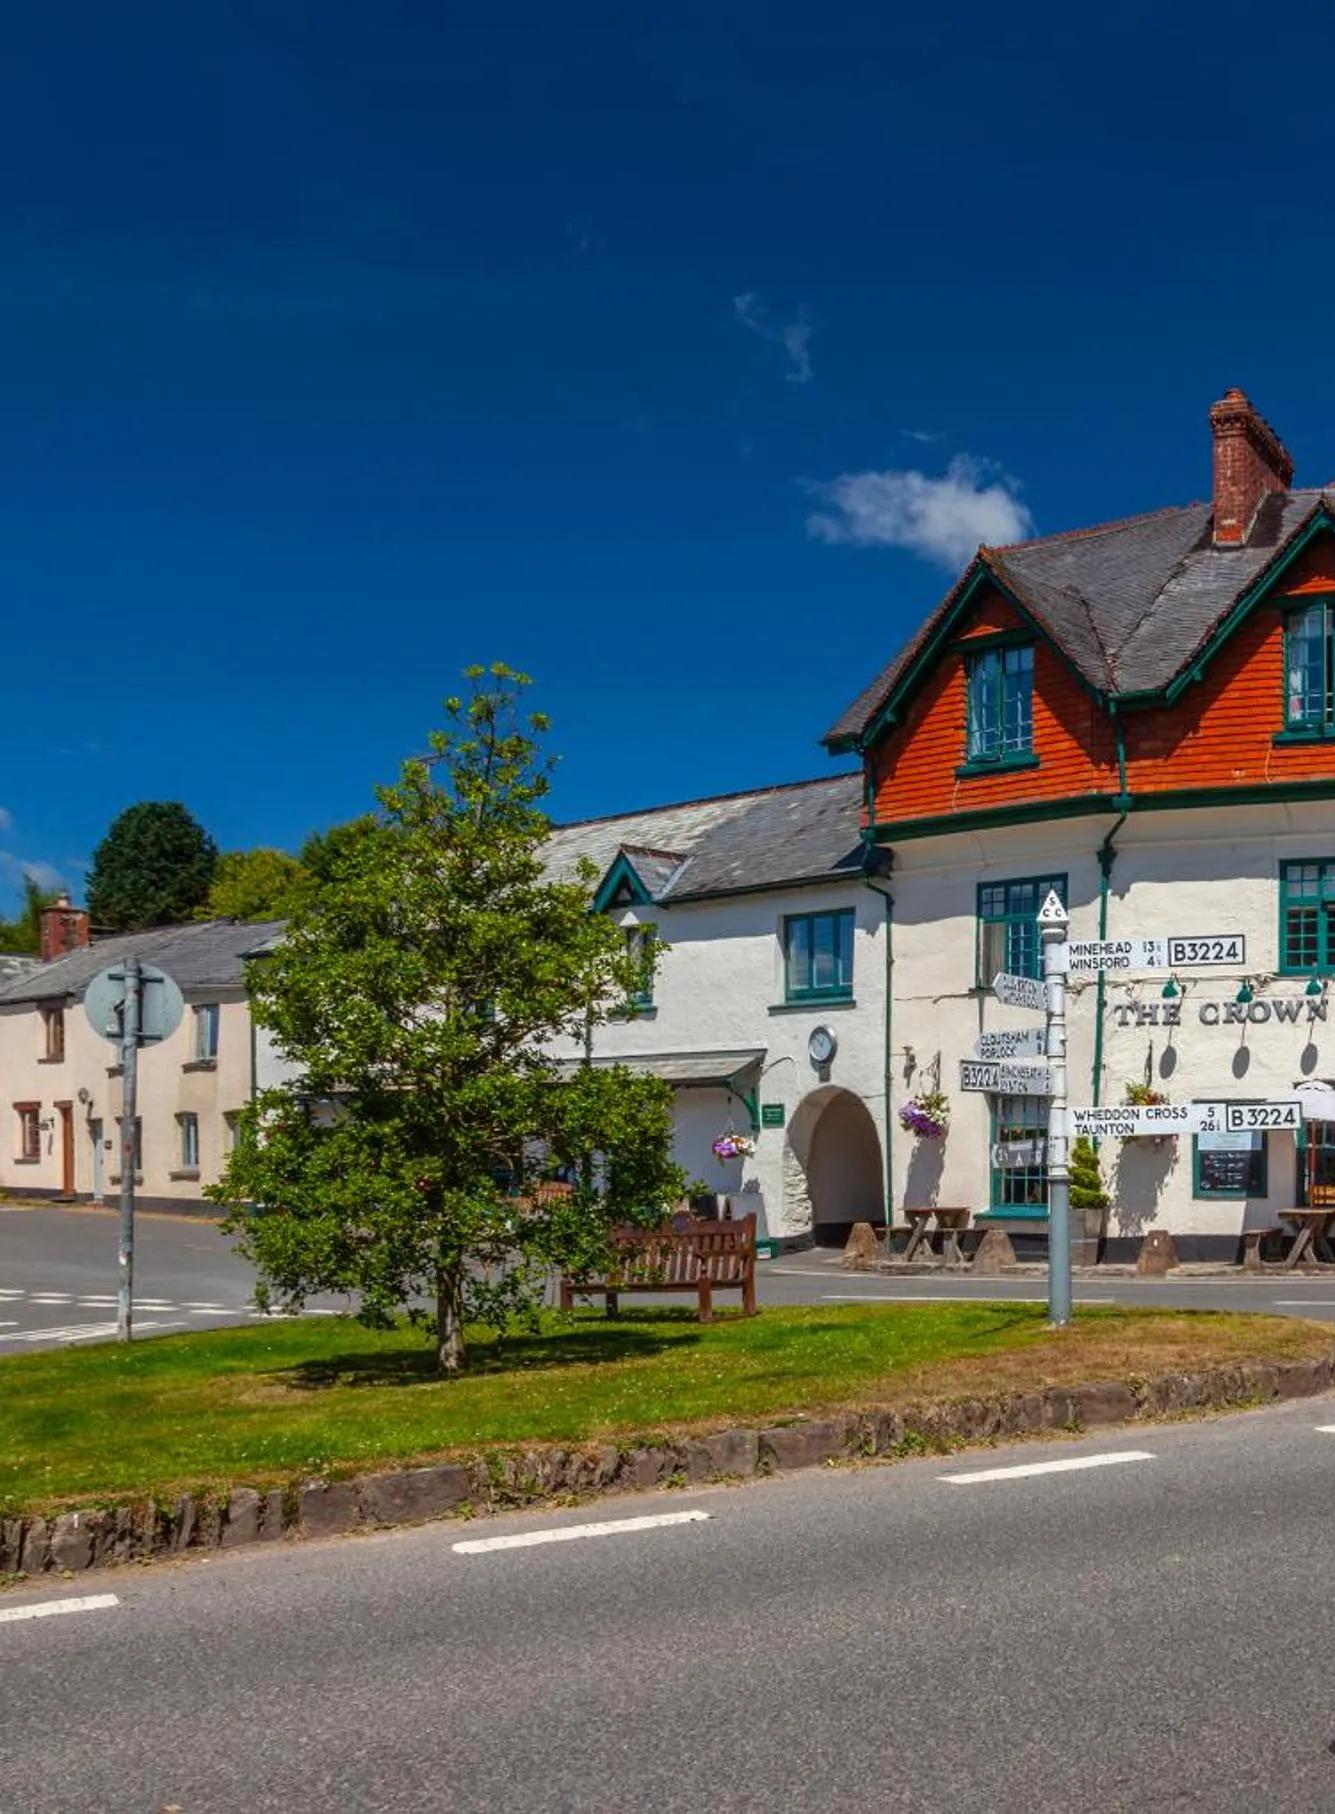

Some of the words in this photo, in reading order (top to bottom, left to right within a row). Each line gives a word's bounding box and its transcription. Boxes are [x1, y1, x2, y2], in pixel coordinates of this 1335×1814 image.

[1069, 942, 1132, 956] MINEHEAD
[1174, 941, 1239, 962] B3224
[1069, 954, 1130, 970] WINSFORD
[1114, 1003, 1181, 1026] THE
[1199, 1000, 1328, 1025] CROWN
[981, 1045, 1017, 1059] PORLOCK
[963, 1065, 998, 1087] B3224
[1074, 1108, 1140, 1122] WHEDDON
[1146, 1106, 1188, 1119] CROSS
[1207, 1106, 1215, 1118] 5
[1074, 1123, 1135, 1135] TAUNTON
